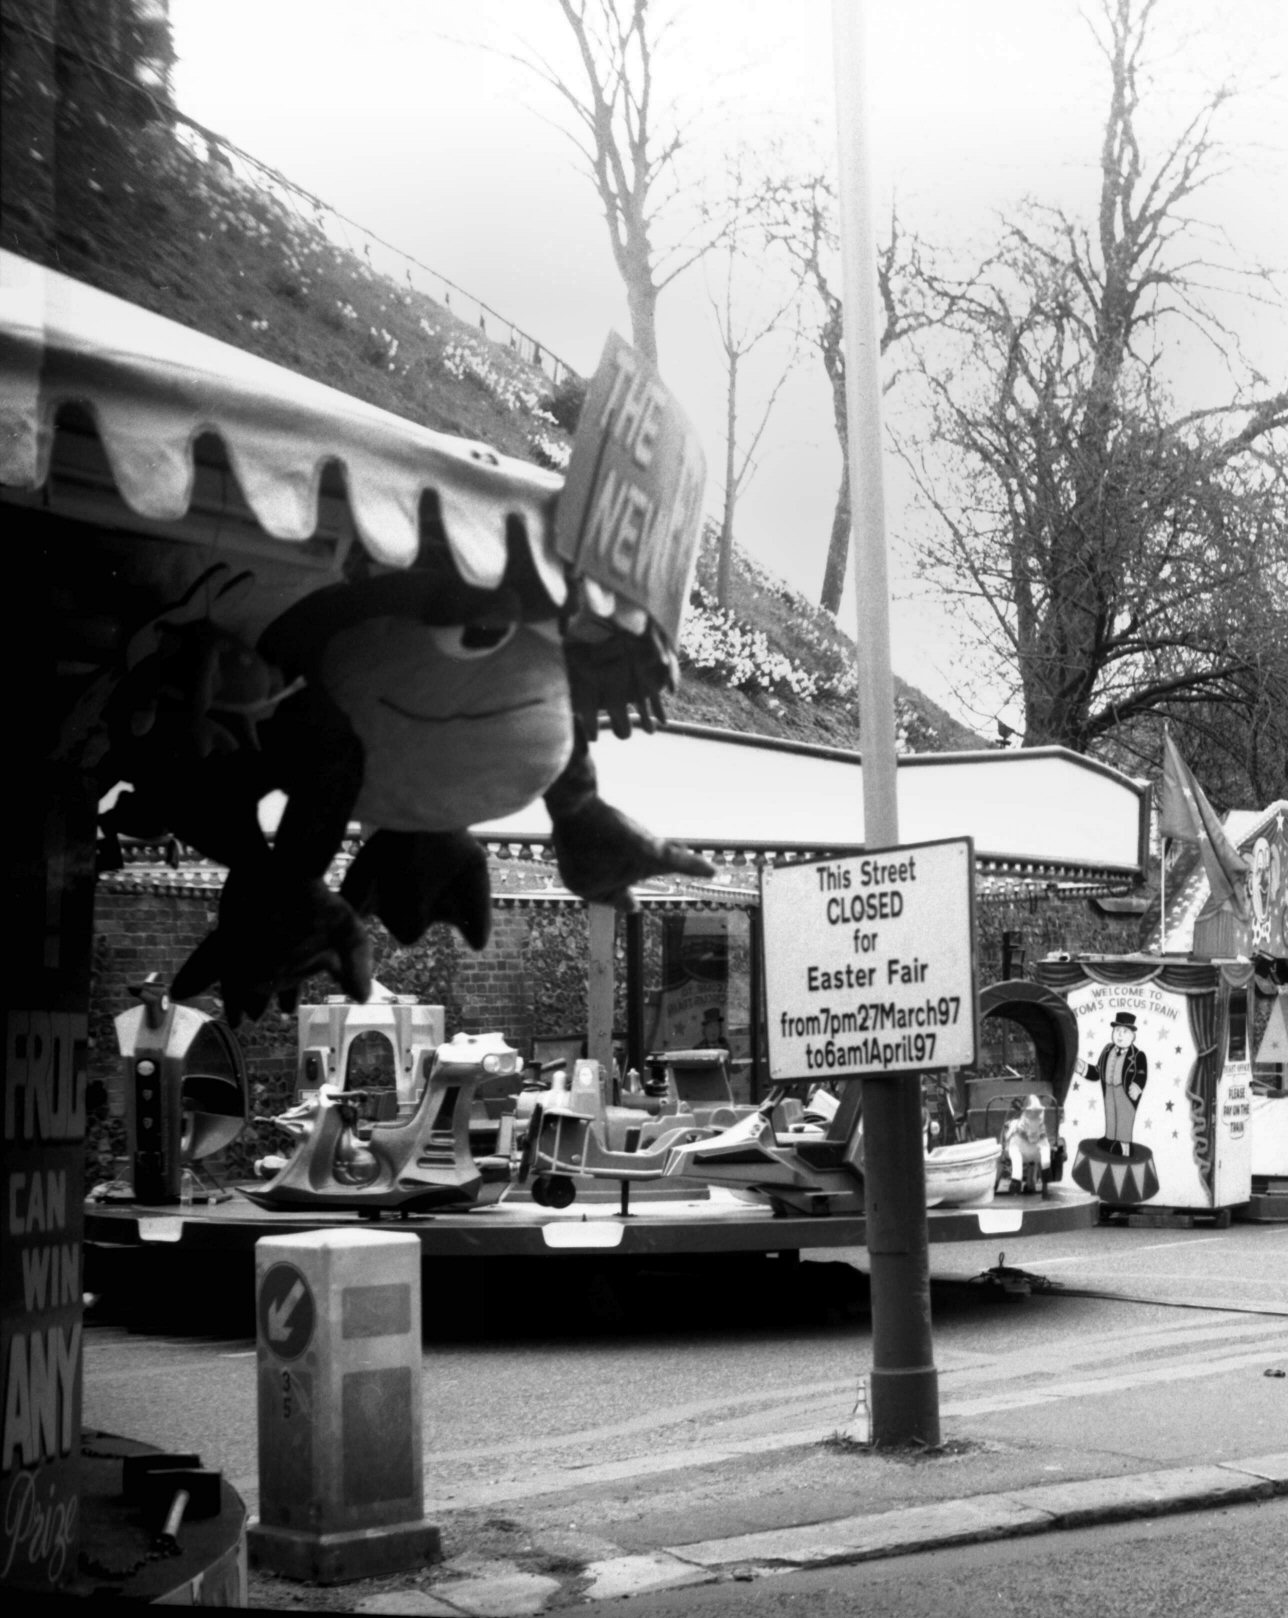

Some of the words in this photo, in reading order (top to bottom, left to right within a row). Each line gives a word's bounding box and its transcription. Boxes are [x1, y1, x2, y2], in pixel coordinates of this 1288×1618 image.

[601, 349, 670, 469] THE
[816, 864, 852, 892] This
[860, 856, 917, 887] Street
[826, 890, 904, 926] CLOSED
[853, 928, 879, 954] for
[807, 963, 877, 992] Easter
[887, 957, 929, 985] Fair
[1091, 986, 1144, 998] WELCOME
[1149, 990, 1163, 1000] TO
[1108, 997, 1146, 1009] CIRCUS
[1149, 1001, 1179, 1020] TRAIN
[4, 1008, 88, 1141] FROG
[1223, 1105, 1232, 1116] PAY
[1232, 1105, 1240, 1116] ON
[1240, 1103, 1250, 1115] THE
[1228, 1087, 1245, 1100] PLEASE
[8, 1169, 67, 1236] CAN
[21, 1242, 81, 1312] WIN
[1, 1321, 83, 1473] ANY
[0, 1468, 79, 1583] Prize
